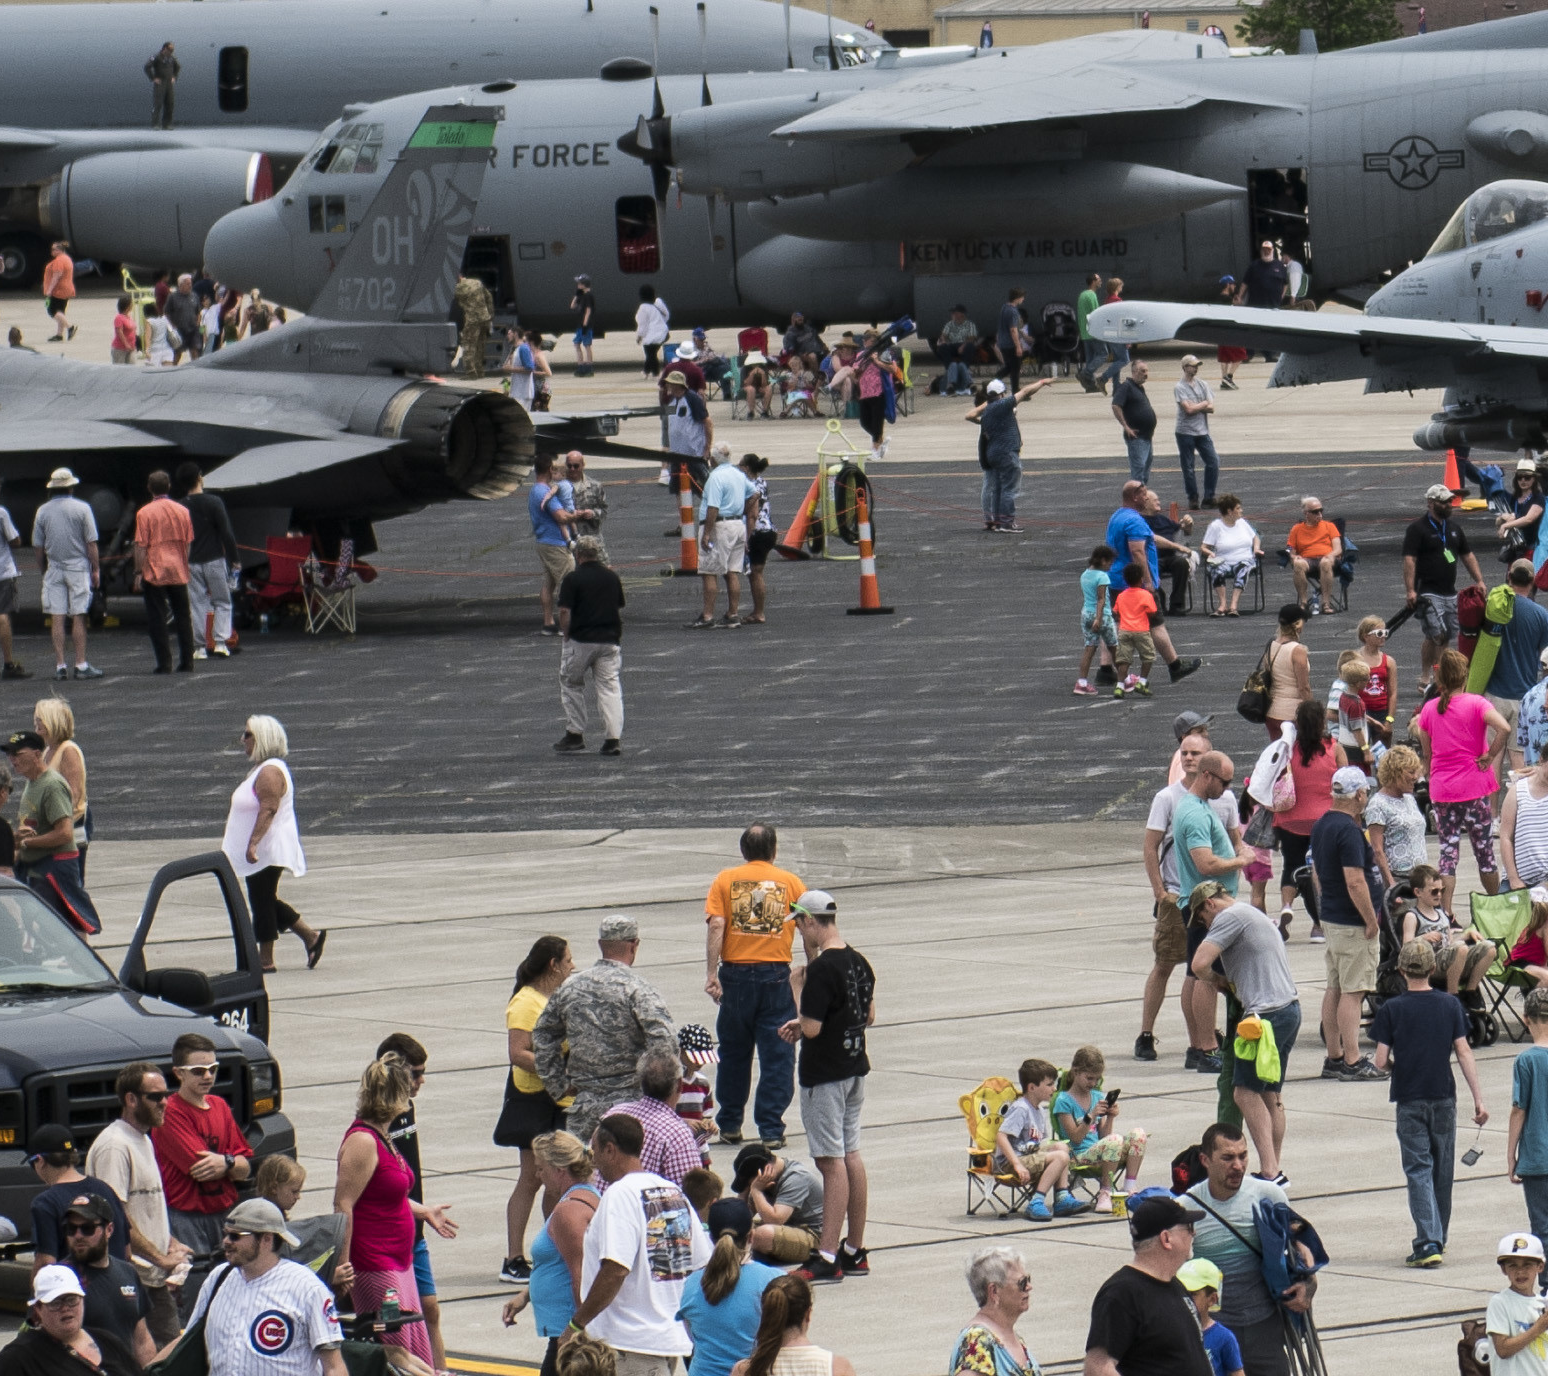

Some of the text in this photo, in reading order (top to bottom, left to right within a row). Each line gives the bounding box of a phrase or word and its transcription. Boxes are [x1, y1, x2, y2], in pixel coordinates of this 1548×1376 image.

[436, 126, 465, 145] Toledo
[512, 143, 610, 168] FORCE
[372, 216, 413, 265] OH
[911, 238, 1129, 262] KENTUCKY AIR GUARD
[353, 278, 397, 311] 702
